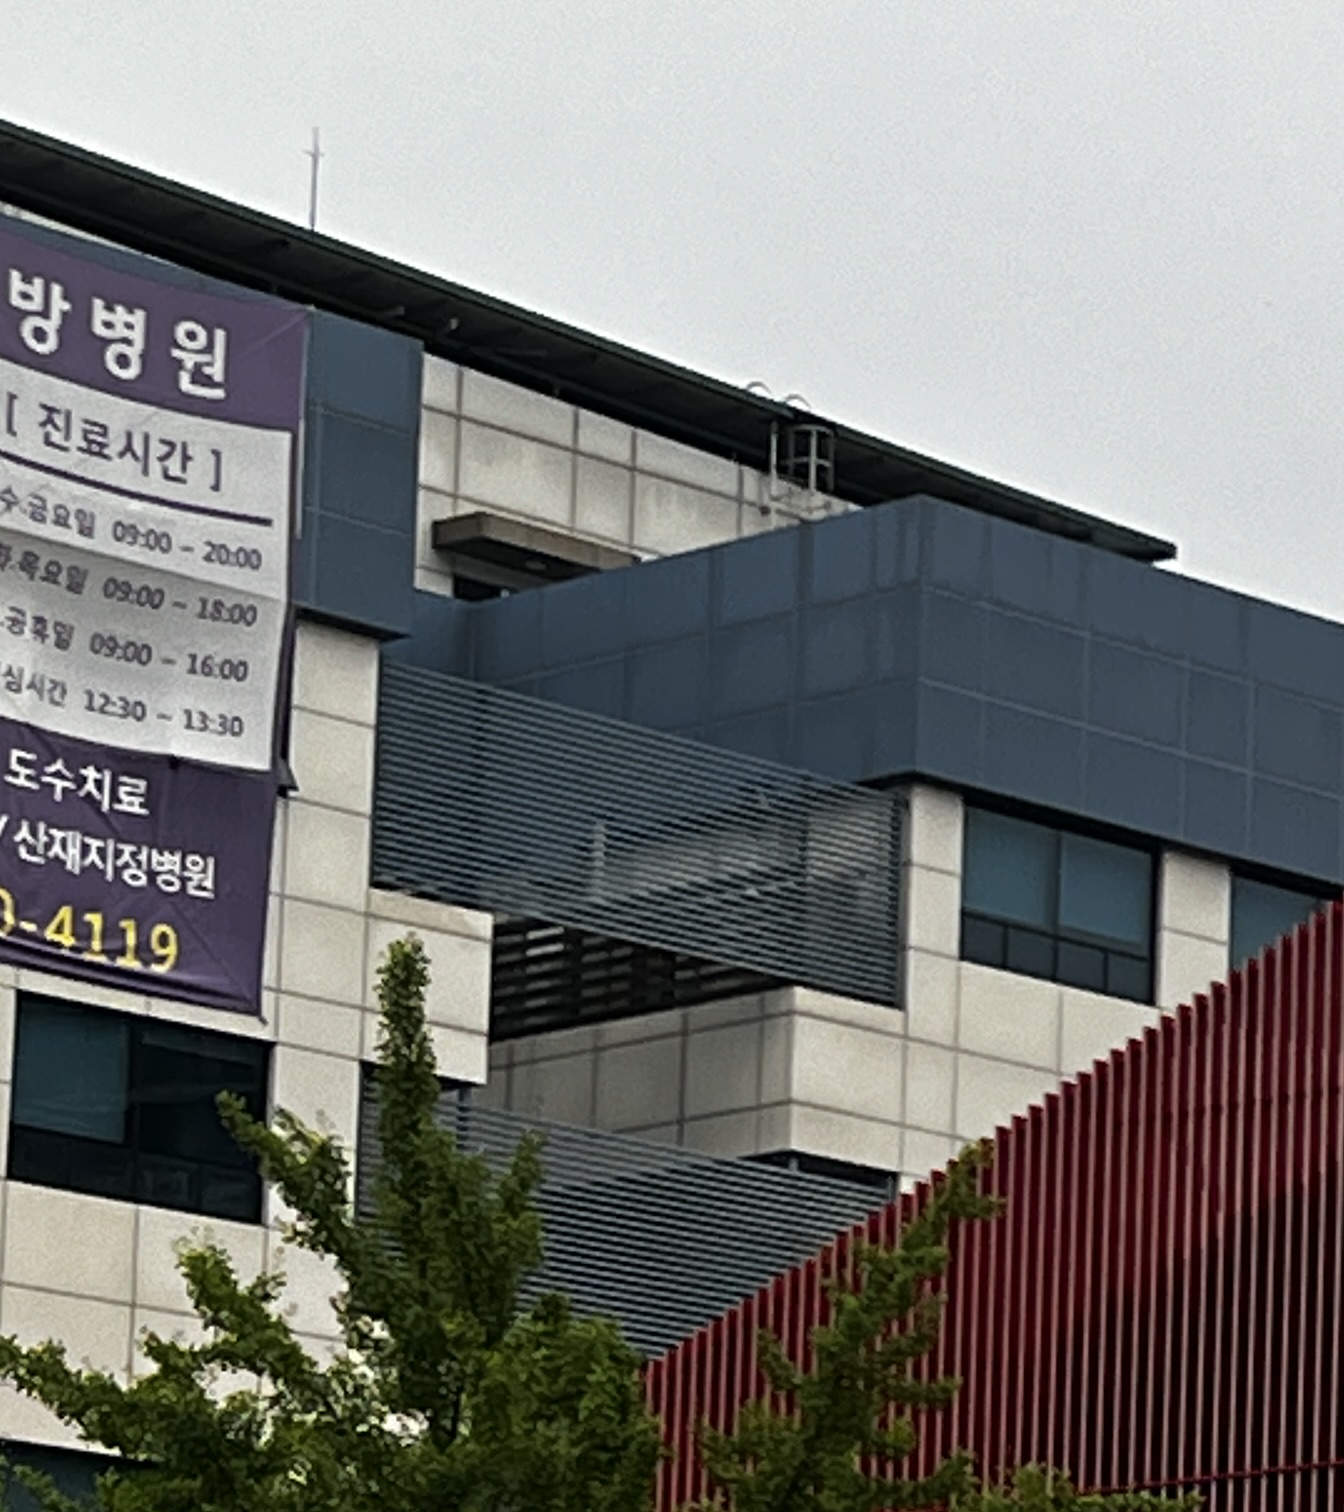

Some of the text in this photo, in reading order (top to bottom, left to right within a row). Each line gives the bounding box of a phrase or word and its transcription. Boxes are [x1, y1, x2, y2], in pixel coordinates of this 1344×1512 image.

[38, 402, 194, 485] 진료시간
[112, 520, 173, 555] 09:00
[202, 540, 263, 571] 20:00
[103, 576, 166, 611] 09:00
[198, 596, 258, 627] 18:00
[89, 631, 153, 666] 09:00
[187, 652, 249, 683] 16:00
[83, 688, 147, 722] 12:30
[182, 708, 244, 737] 13:30
[4, 748, 150, 816] 도수치료
[13, 819, 215, 899] 산재지정병원
